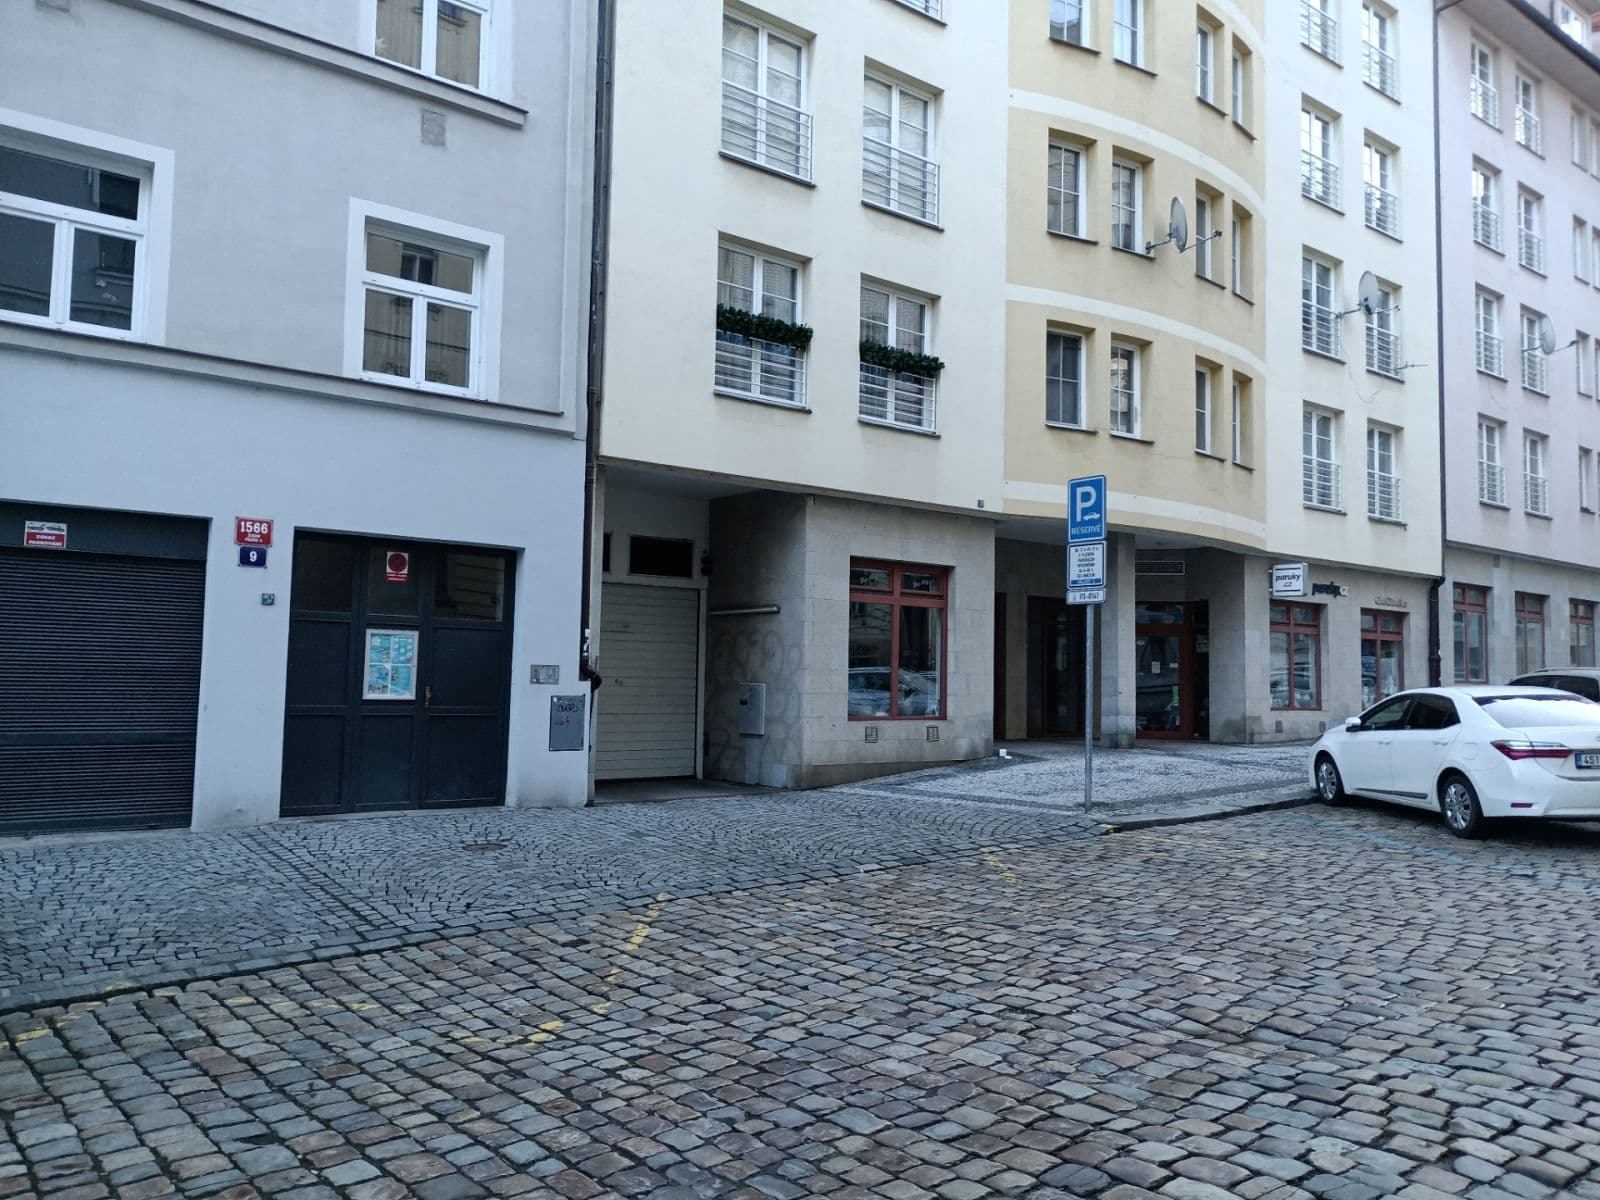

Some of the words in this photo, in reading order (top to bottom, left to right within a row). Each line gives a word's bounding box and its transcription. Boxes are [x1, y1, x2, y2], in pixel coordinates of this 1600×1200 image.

[1076, 486, 1096, 522] P
[240, 521, 268, 534] 1566
[249, 550, 257, 562] 9
[1275, 573, 1301, 582] paruky
